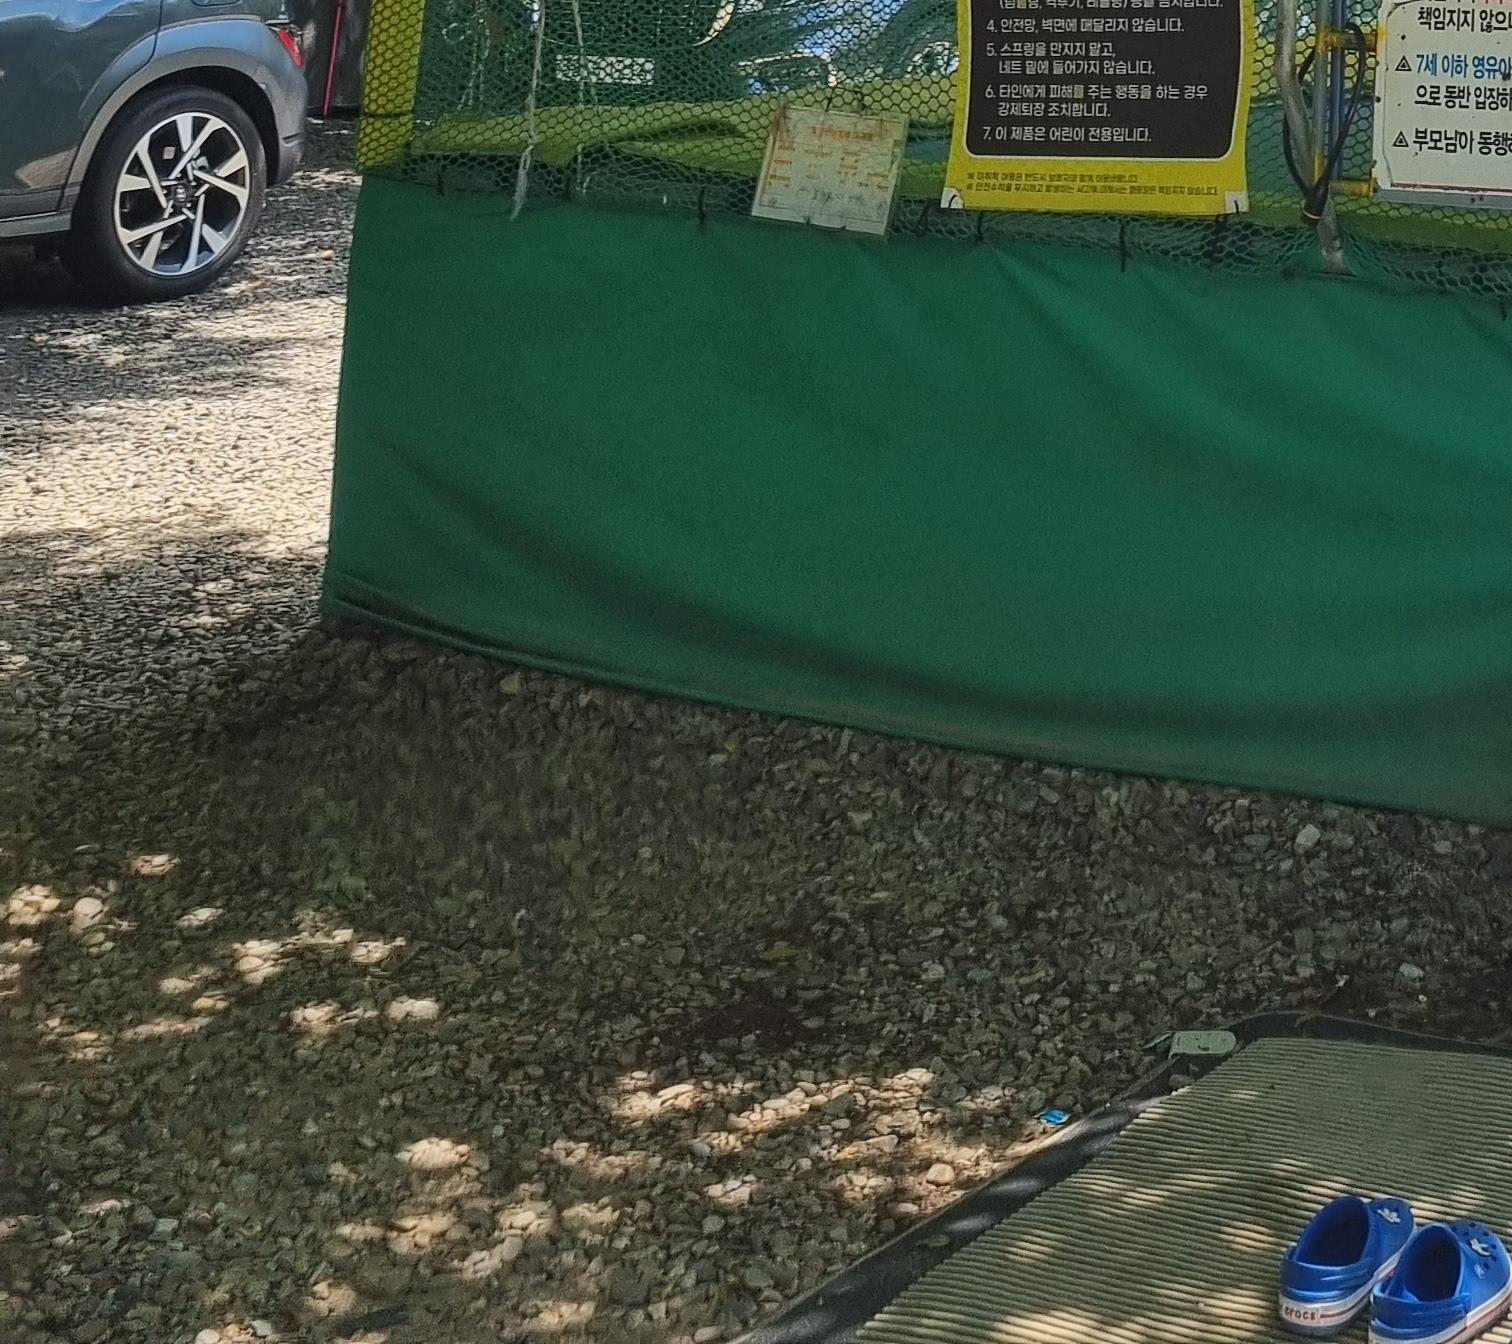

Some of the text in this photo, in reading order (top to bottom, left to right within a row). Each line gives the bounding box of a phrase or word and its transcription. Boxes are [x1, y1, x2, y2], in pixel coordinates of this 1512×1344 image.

[987, 18, 1185, 34] 4. 안전망, 벽면에 매달리지 않습니다.
[1418, 6, 1475, 32] 책임지지
[987, 42, 1116, 58] 5. 스프링을 만지지 말고,
[999, 61, 1022, 75] 네트
[1053, 60, 1100, 75] 들어가지
[1103, 60, 1155, 75] 않습니다.
[1416, 53, 1437, 77] 7세
[1441, 54, 1468, 78] 이하
[985, 84, 996, 98] 6.
[999, 84, 1046, 99] 타인에게
[1088, 84, 1113, 99] 주는
[1115, 84, 1151, 99] 행동을
[1156, 84, 1180, 99] 하는
[1184, 84, 1208, 99] 경우
[1414, 84, 1441, 106] 으로
[1444, 86, 1471, 109] 동반
[998, 102, 1111, 117] 강제퇴장 조치합니다.
[983, 126, 1151, 142] 7. 이 제품은 어린이 전용입니다.
